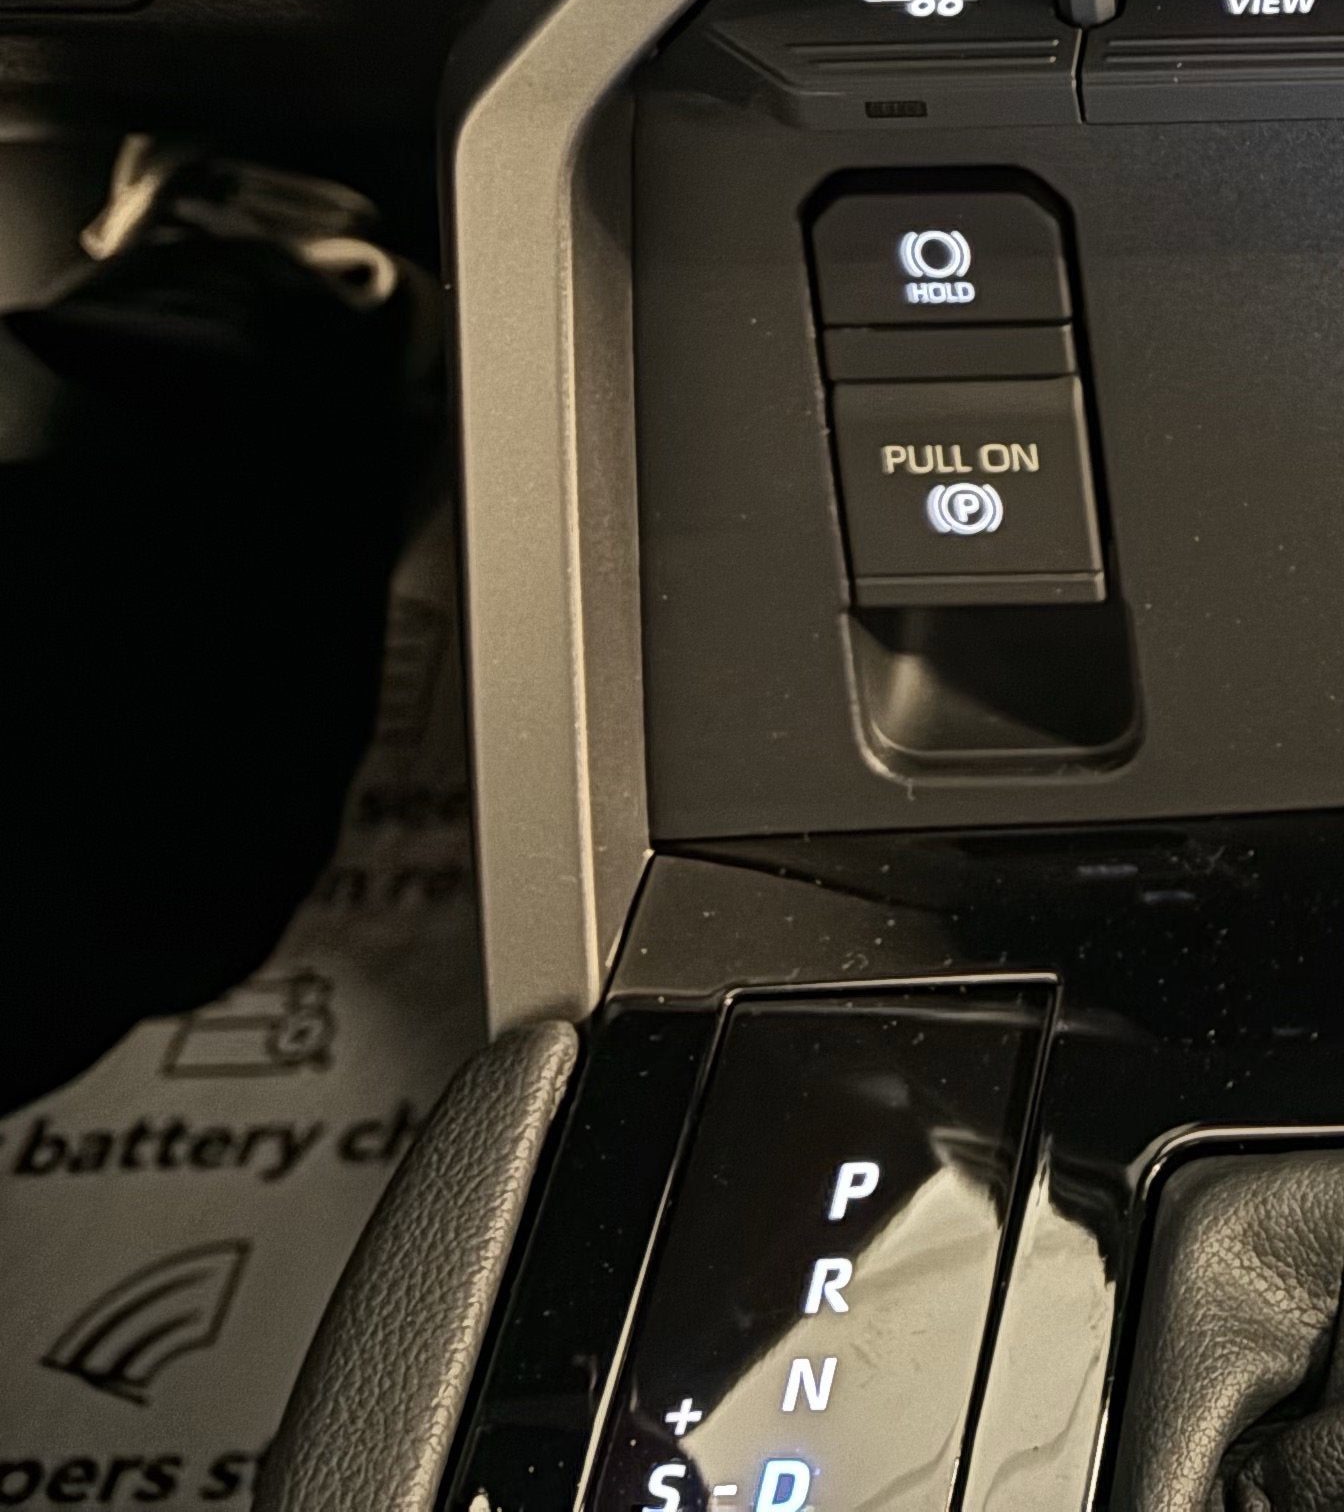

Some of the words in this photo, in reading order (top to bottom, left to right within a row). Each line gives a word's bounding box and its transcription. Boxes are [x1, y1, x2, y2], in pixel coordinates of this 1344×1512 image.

[905, 281, 976, 303] HOLD
[882, 444, 973, 474] PULL
[979, 443, 1040, 473] ON
[13, 1115, 325, 1183] battery
[827, 1161, 880, 1221] P
[804, 1256, 854, 1314] R
[782, 1356, 838, 1412] N
[641, 1463, 687, 1512] S
[755, 1458, 812, 1512] D
